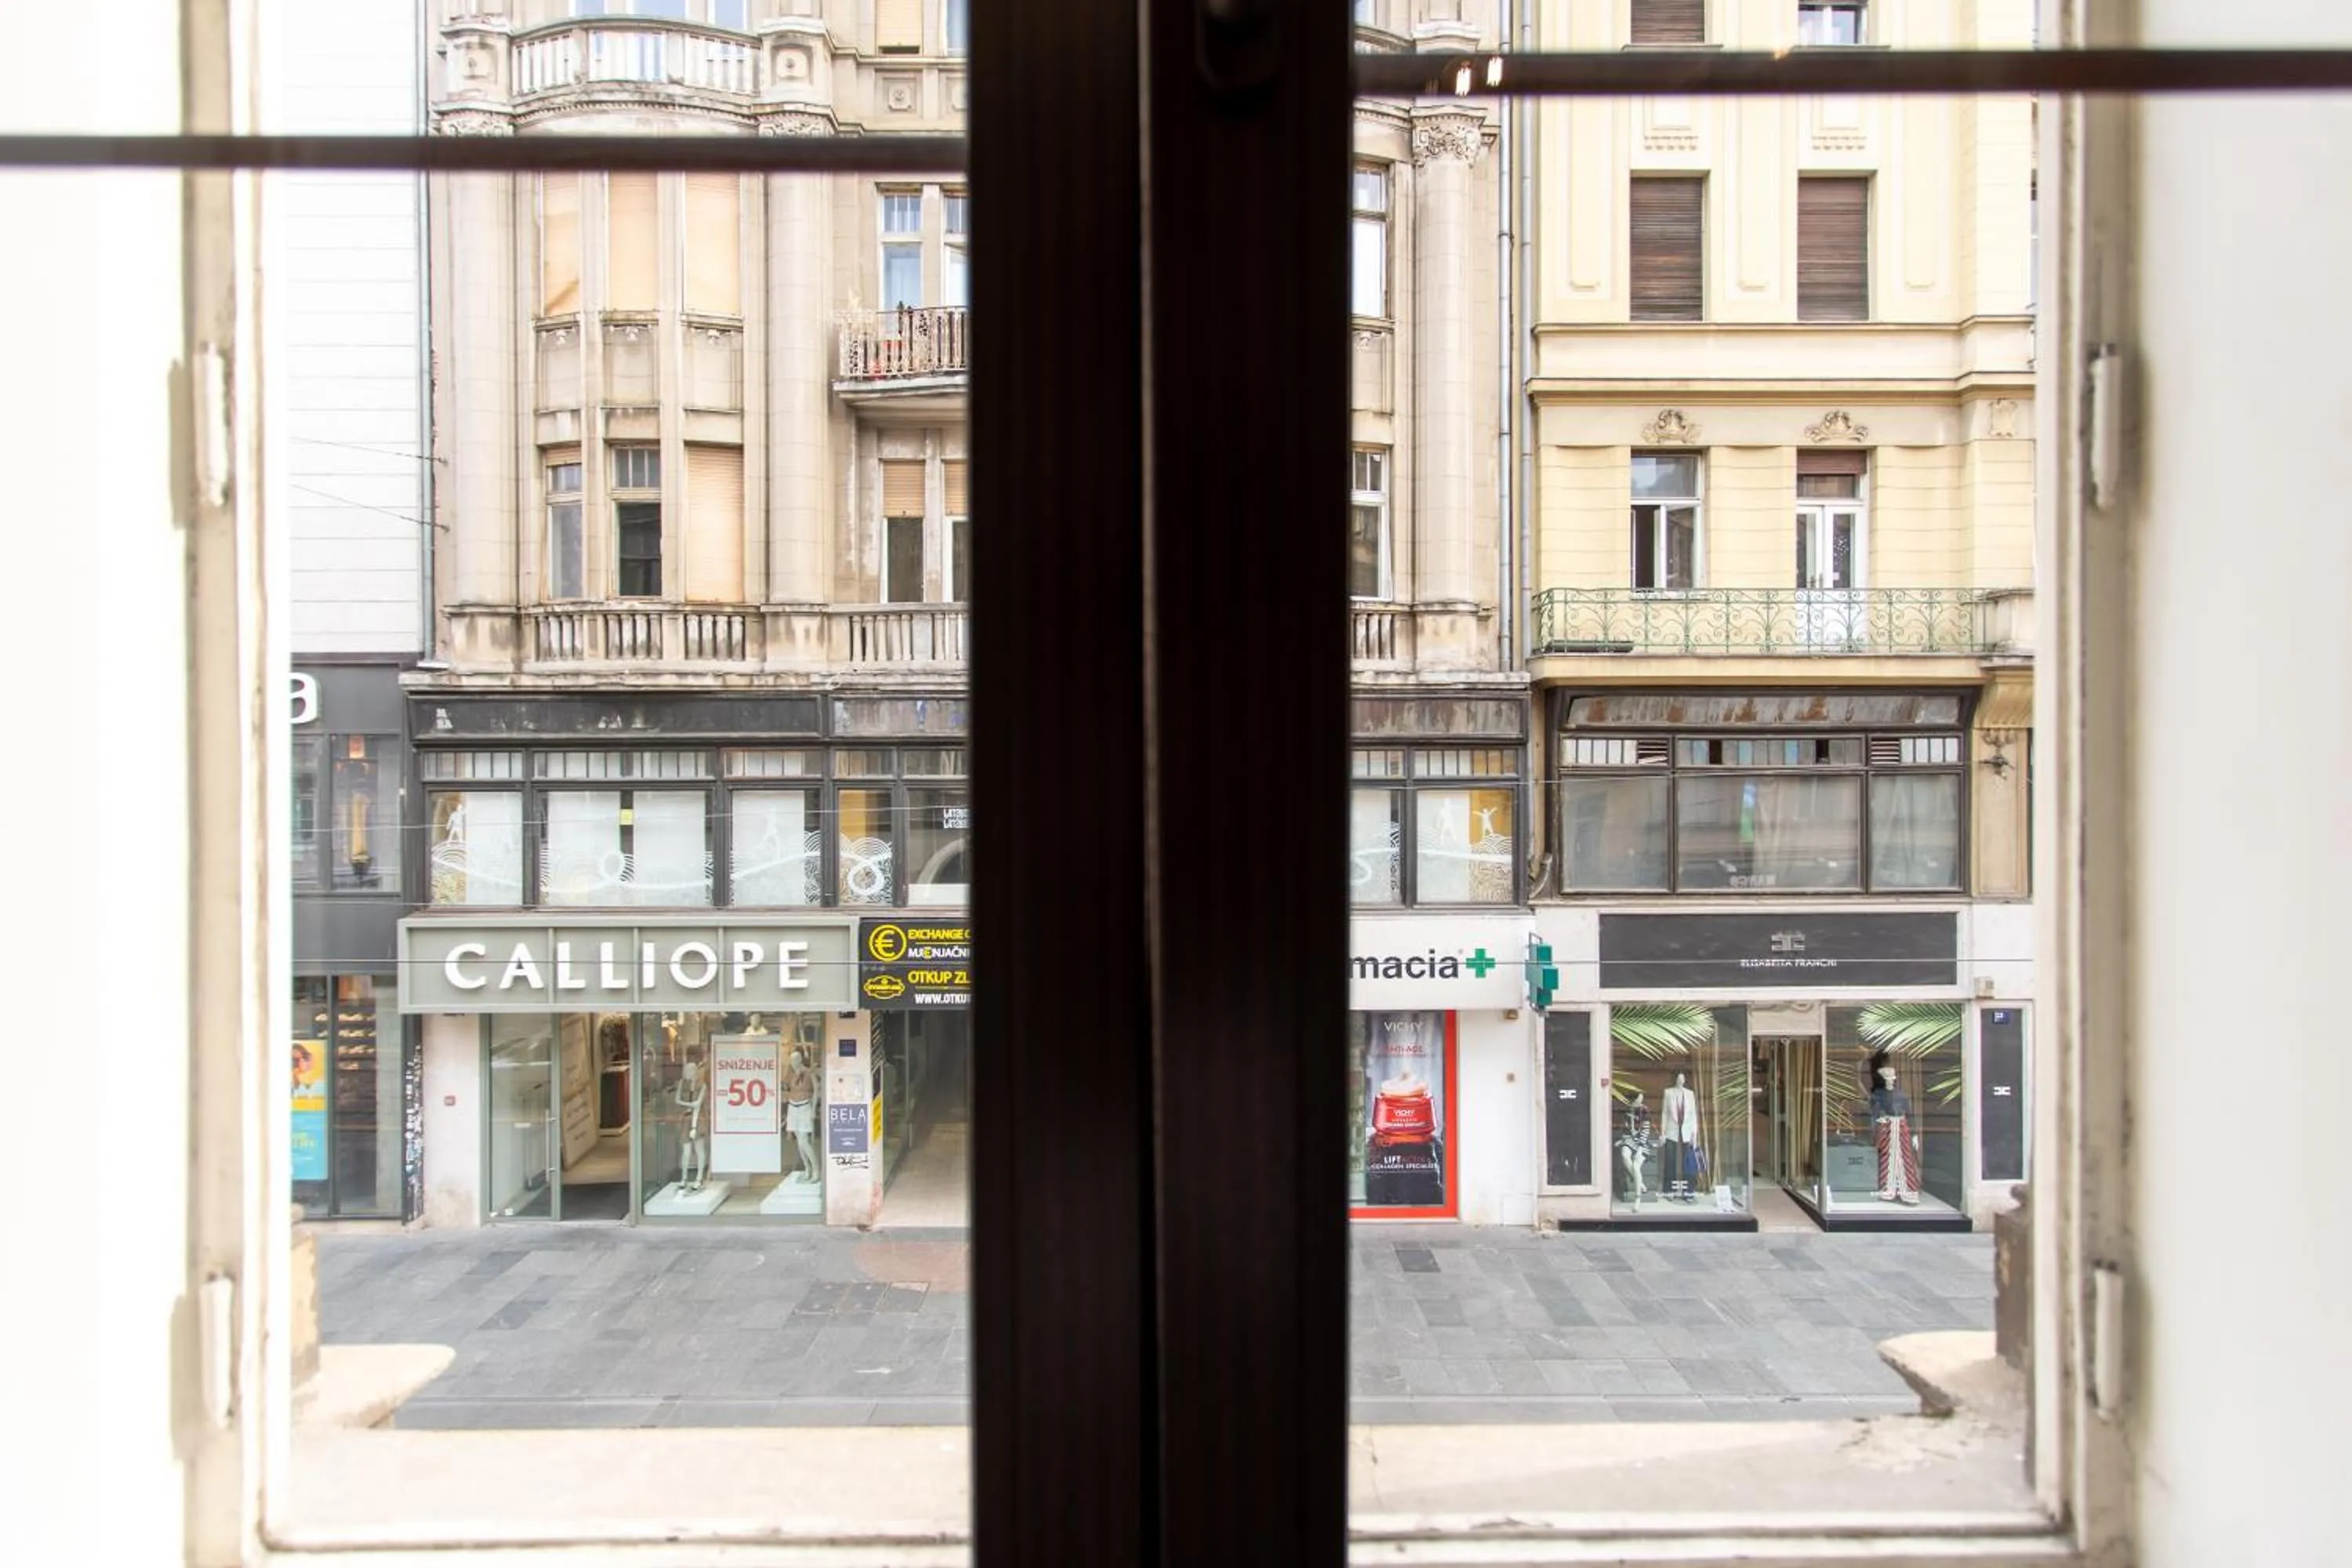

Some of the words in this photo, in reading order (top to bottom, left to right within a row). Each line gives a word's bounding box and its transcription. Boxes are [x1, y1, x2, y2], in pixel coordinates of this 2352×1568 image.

[908, 928, 963, 939] EXCHANGE
[444, 942, 809, 989] CALLIOPE
[908, 971, 952, 984] OTKUP
[1384, 1022, 1424, 1033] VICHY
[717, 1058, 775, 1070] SNIŽENJE
